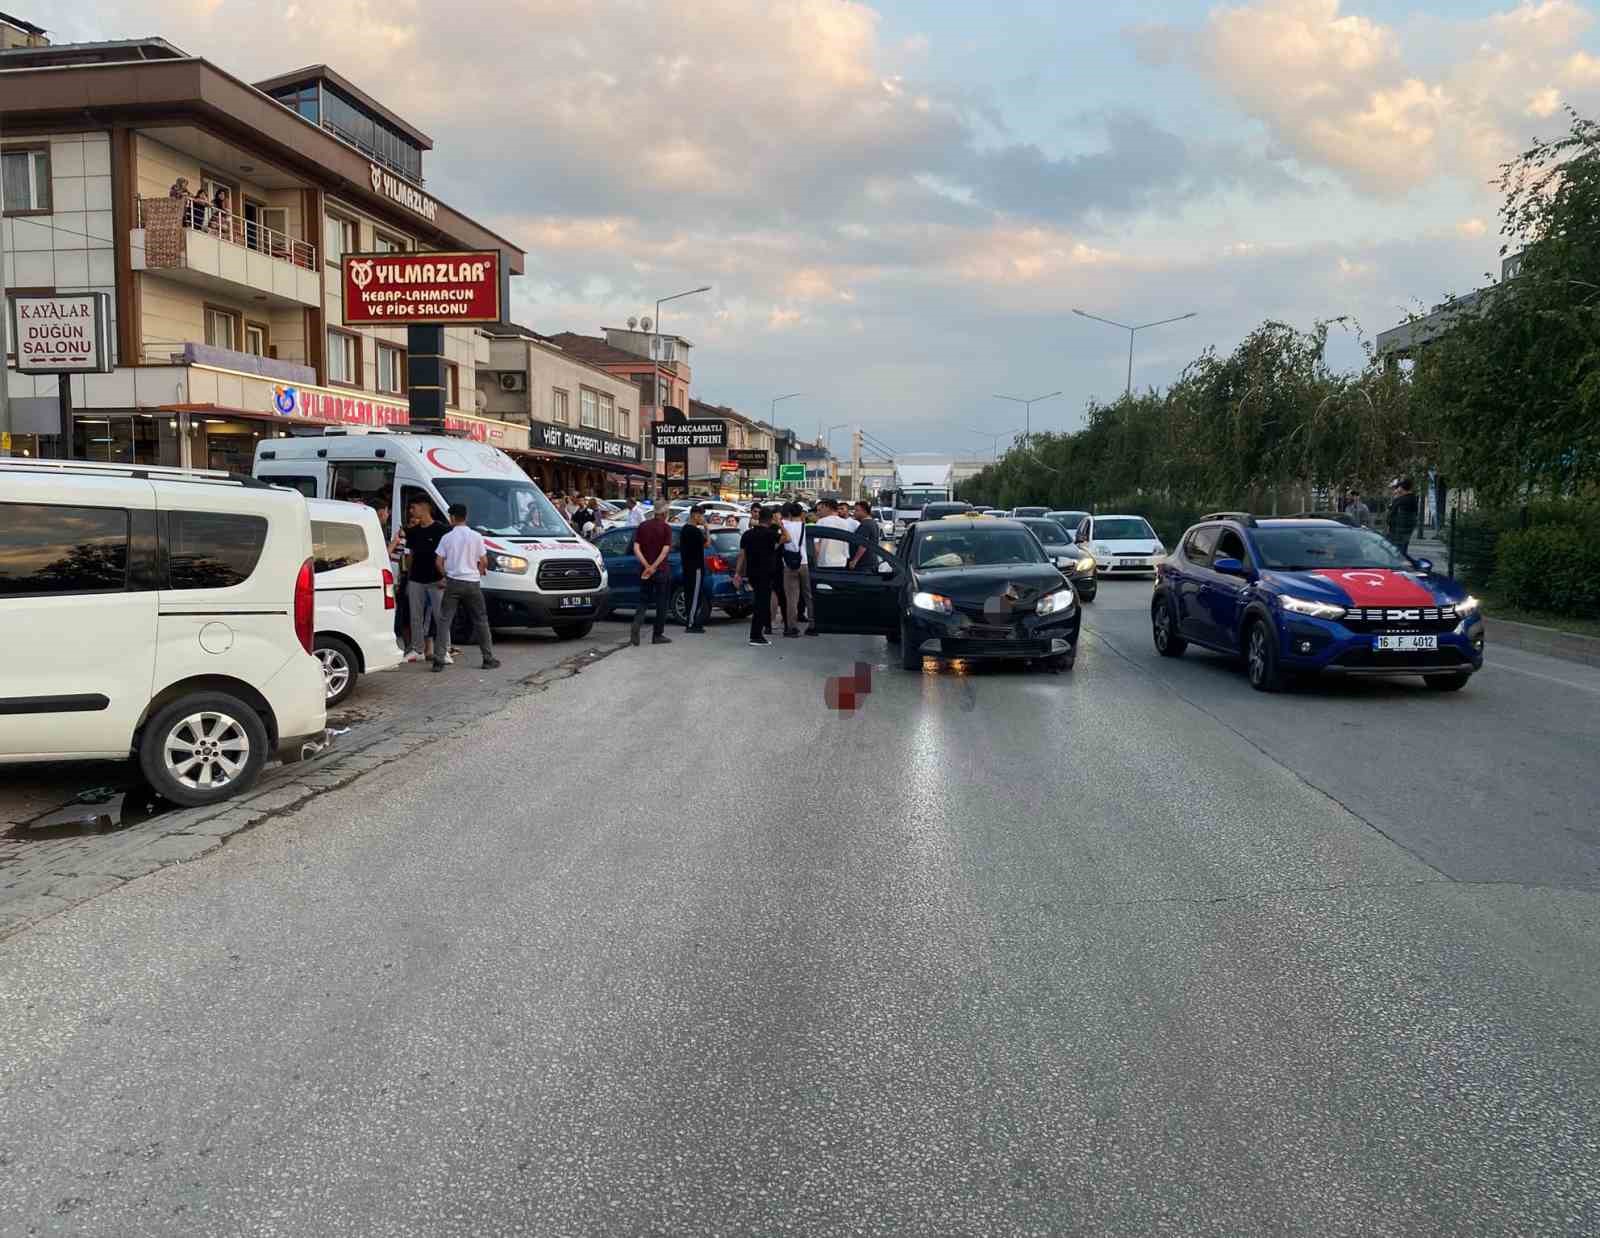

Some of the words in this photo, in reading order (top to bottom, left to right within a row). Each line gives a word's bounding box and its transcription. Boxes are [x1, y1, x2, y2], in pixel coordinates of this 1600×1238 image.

[383, 173, 436, 220] YILMAZLAR
[375, 262, 485, 284] YILMAZLAR
[362, 289, 474, 302] KEBAP-LAHMACUN
[20, 302, 91, 320] KAYALAR
[368, 304, 384, 316] VE
[386, 302, 416, 315] PİDE
[418, 303, 468, 315] SALONU
[28, 323, 83, 339] DÜĞÜN
[23, 341, 91, 354] SALONU
[300, 391, 373, 426] YILMAZLAR
[657, 435, 690, 445] EKMEK
[693, 434, 721, 445] FIRINI
[1379, 637, 1389, 648] 16
[1412, 636, 1434, 647] 4012
